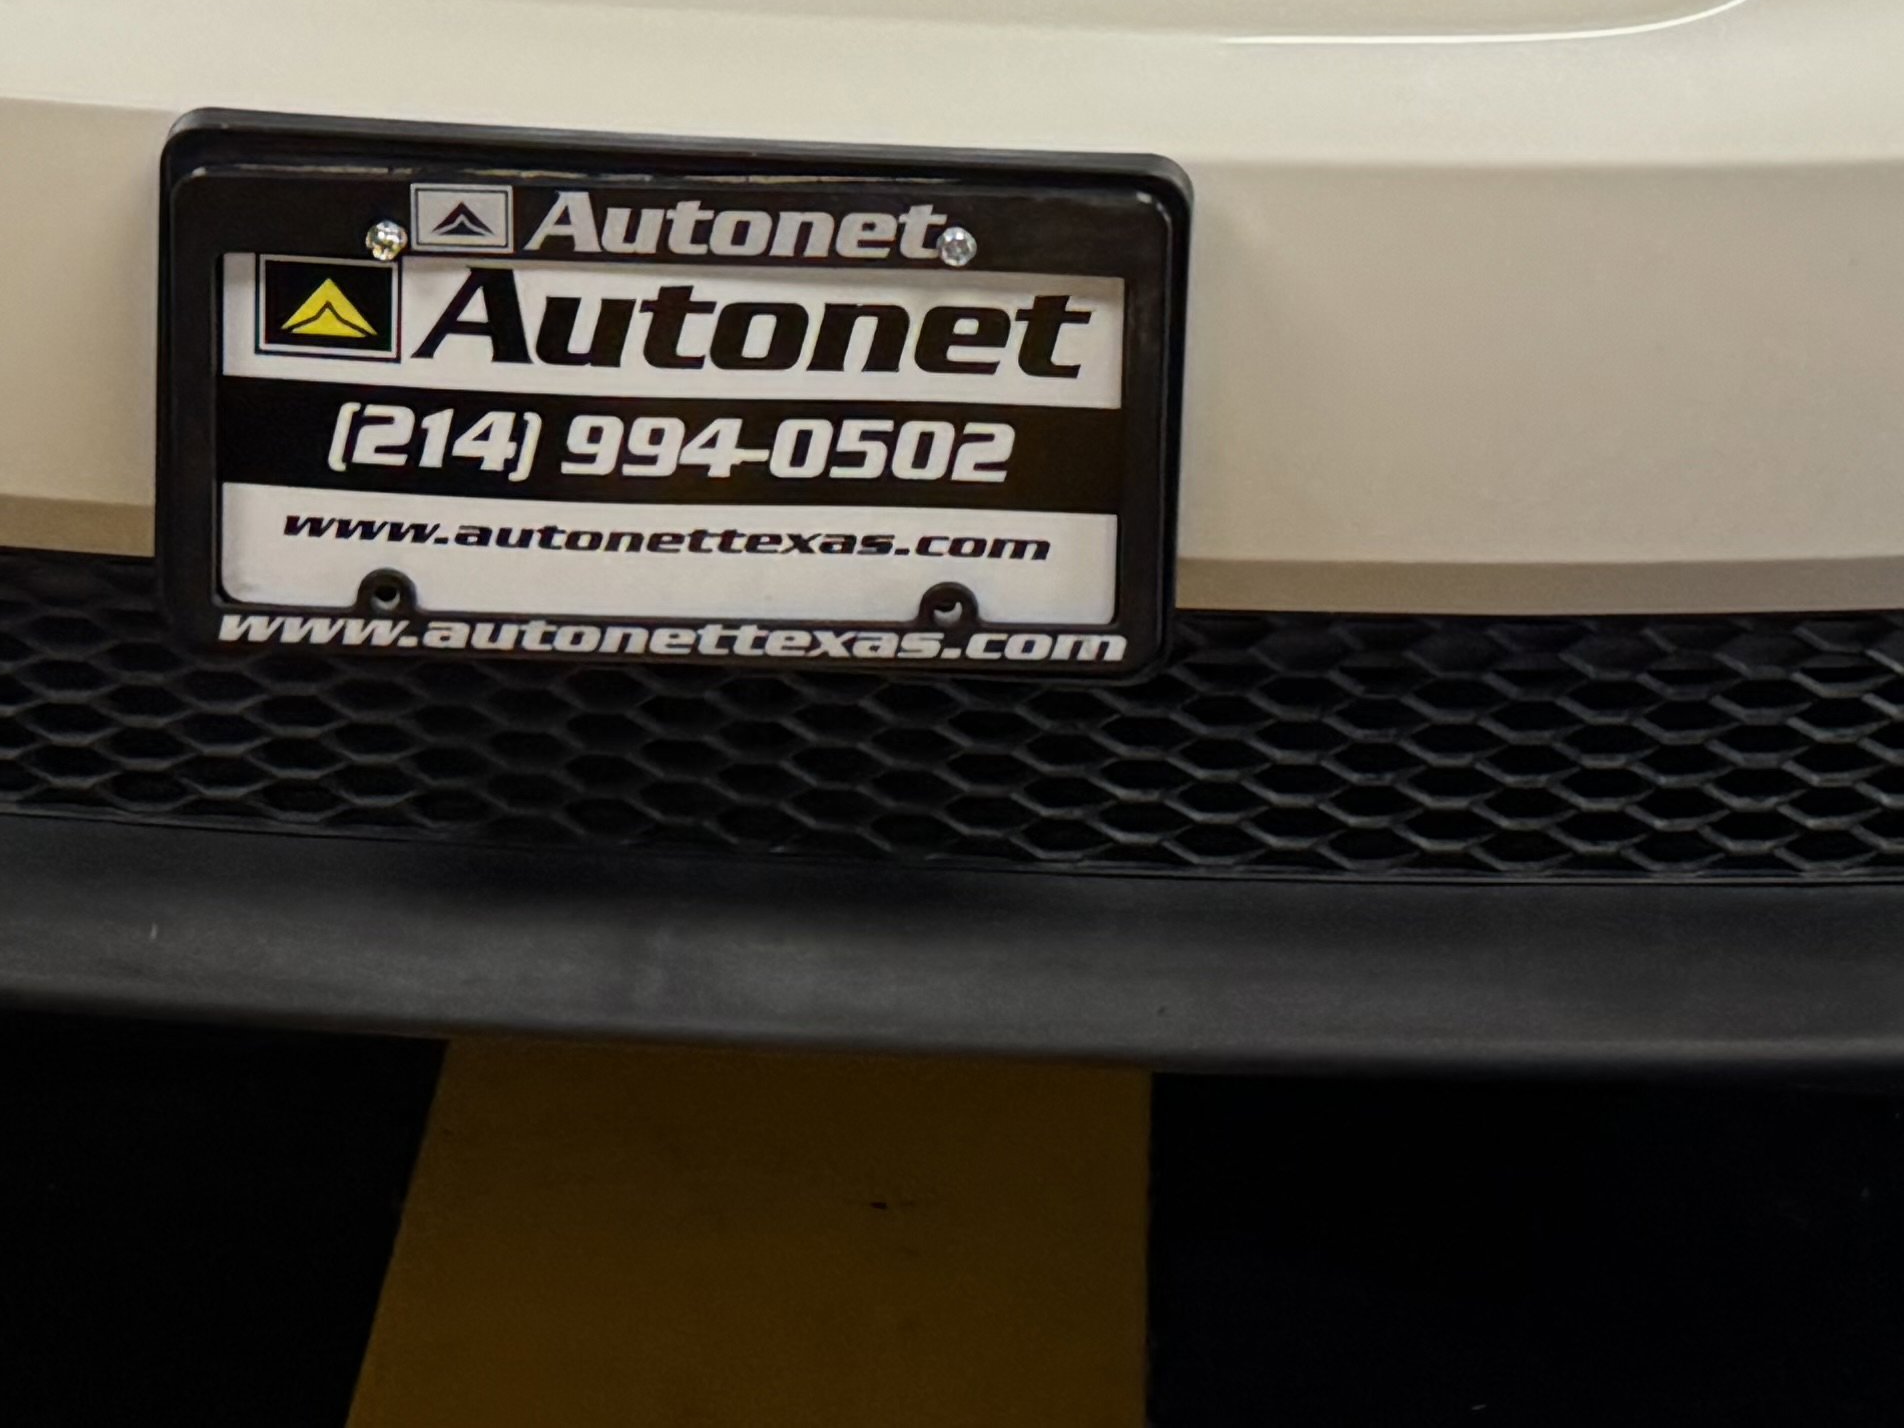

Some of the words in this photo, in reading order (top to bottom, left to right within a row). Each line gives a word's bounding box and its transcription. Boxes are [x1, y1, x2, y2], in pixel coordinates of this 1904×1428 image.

[525, 191, 946, 259] Autonet
[410, 267, 1092, 379] Autonet
[328, 401, 542, 481] (214)
[560, 412, 1016, 483] 994-0502
[283, 515, 1051, 561] www.autonettexas.com
[219, 613, 1128, 662] www.autonettexas.com
